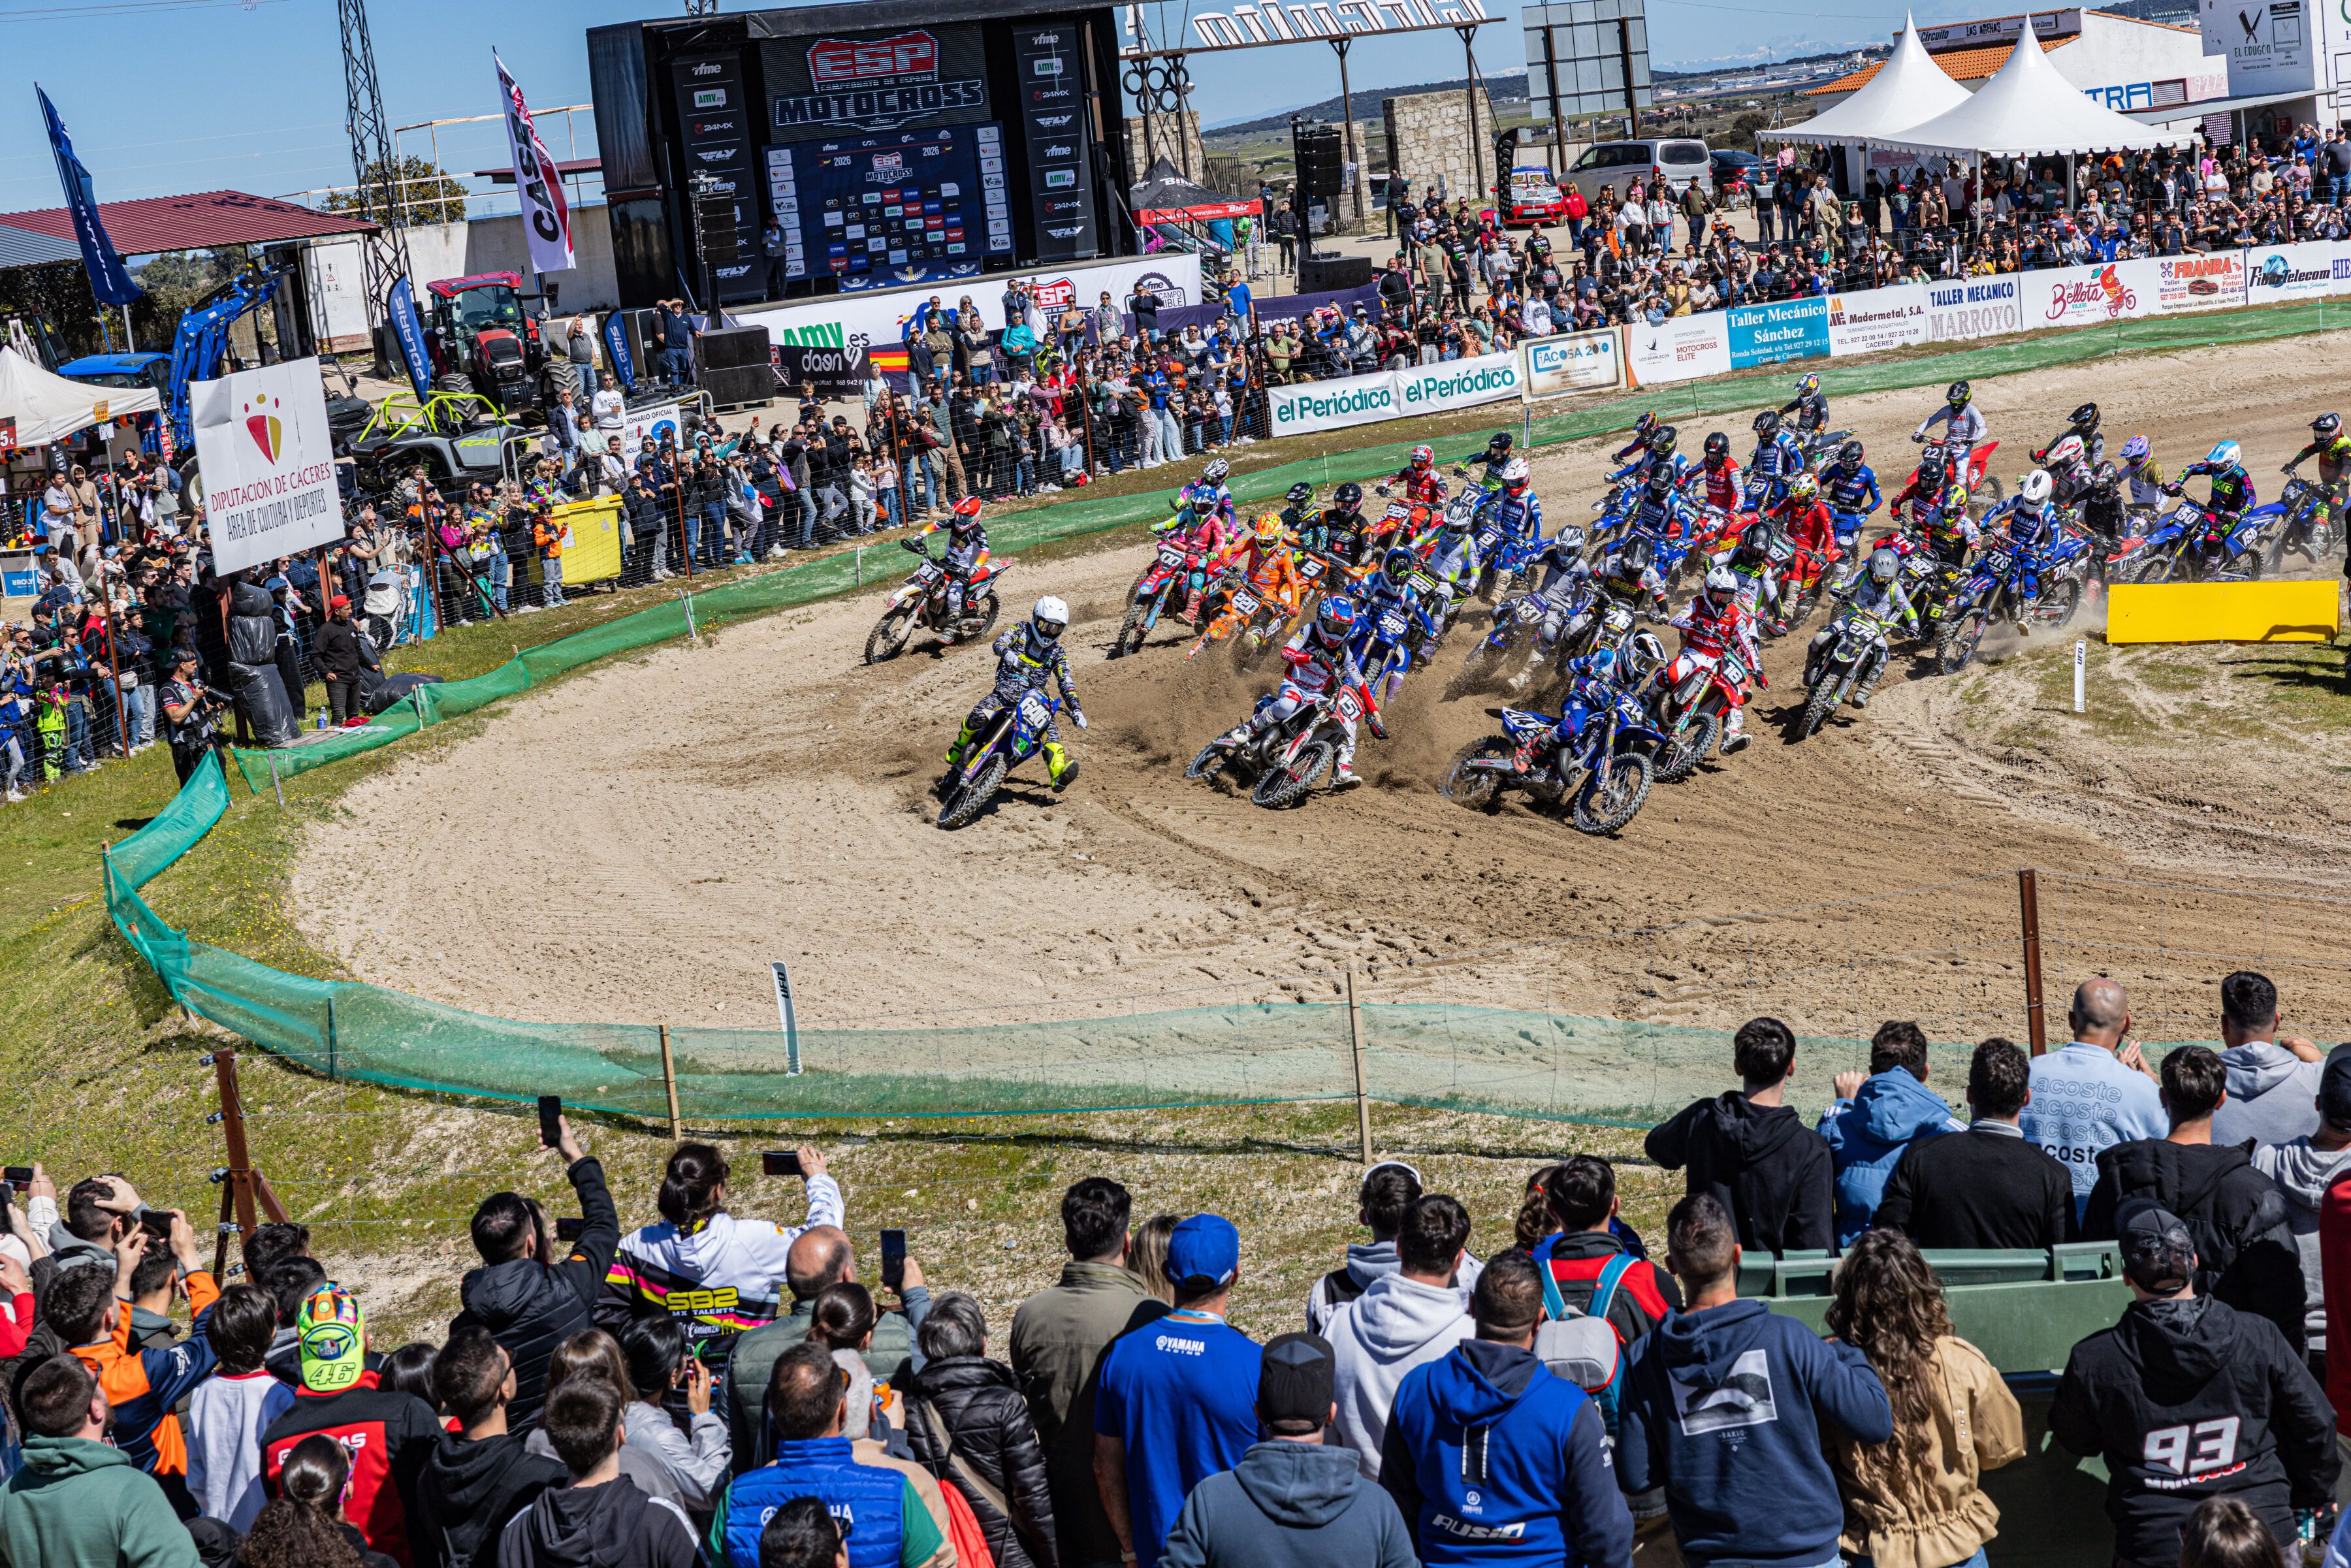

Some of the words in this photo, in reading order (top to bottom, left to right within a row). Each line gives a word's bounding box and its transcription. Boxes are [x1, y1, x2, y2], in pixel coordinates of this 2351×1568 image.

[1032, 33, 1059, 45] rfme
[1921, 29, 1949, 42] Circuito
[1966, 25, 1977, 37] LAS
[1979, 22, 2001, 35] ARENAS
[816, 42, 932, 78] ESP
[693, 63, 722, 76] rfme
[1043, 89, 1070, 98] 24MX
[2085, 82, 2152, 110] TRA
[776, 79, 984, 126] MOTOCROSS
[704, 122, 733, 131] 24MX
[1036, 115, 1073, 124] FLY
[697, 148, 737, 159] FLY
[923, 146, 939, 156] 2026
[1045, 144, 1072, 157] rfme
[834, 156, 851, 166] 2026
[874, 155, 901, 167] ESP
[866, 168, 913, 182] MOTOCROSS
[1160, 176, 1195, 187] Bihr
[1054, 200, 1081, 210] 24MX
[1047, 225, 1084, 235] FLY
[905, 266, 914, 280] 1
[959, 264, 968, 274] 3
[2174, 257, 2232, 279] FRANRA
[2284, 283, 2308, 292] Networking
[2309, 281, 2329, 291] Solutions
[1159, 290, 1181, 300] CAMPO
[1930, 287, 1964, 308] TALLER
[1967, 281, 2014, 303] MECANICO
[2045, 281, 2104, 320] Bellota
[1727, 311, 1765, 328] Taller
[1768, 303, 1826, 321] Mecánico
[1849, 308, 1907, 325] Madermetal,
[1909, 304, 1925, 316] S.A.
[1930, 304, 2017, 339] MARROYO
[1754, 325, 1804, 344] Sánchez
[1847, 325, 1877, 334] SUMINISTROS
[1877, 320, 1909, 330] INDUSTRIALES
[394, 295, 426, 381] POLARIS
[1865, 340, 1894, 349] CACERES
[1585, 342, 1609, 356] 2010
[1676, 342, 1718, 354] MOTOCROSS
[1731, 349, 1750, 359] Ronda
[1750, 346, 1774, 357] Soledad,
[1774, 344, 1783, 353] s/n
[1677, 352, 1696, 362] ELITE
[1757, 355, 1773, 364] Casar
[1782, 351, 1804, 360] Cáceres
[1485, 364, 1512, 372] Extremadura
[1362, 384, 1390, 393] Extremadura
[1406, 379, 1422, 403] el
[1423, 367, 1516, 400] Periódico
[1277, 398, 1295, 423] el
[1300, 388, 1391, 420] Periódico
[651, 408, 673, 419] OFICIAL
[458, 438, 498, 448] RZR
[1926, 447, 1940, 458] 22
[211, 477, 272, 512] DIPUTACIÓN
[274, 471, 289, 494] DE
[289, 462, 331, 489] CÁCERES
[1748, 481, 1766, 494] 223
[1836, 491, 1855, 501] YAMAHA
[226, 511, 249, 541] ÁREA
[248, 513, 259, 534] DE
[260, 503, 289, 534] CULTURA
[288, 500, 293, 528] Y
[293, 487, 327, 522] DEPORTES
[1386, 504, 1409, 517] 229
[1503, 503, 1523, 516] YAMAHA
[1642, 502, 1664, 516] YAMAHA
[2173, 507, 2200, 526] 150
[2014, 513, 2038, 528] YAMAHA
[1478, 532, 1496, 546] 9
[1893, 532, 1915, 551] 374
[2241, 526, 2259, 547] 150
[1160, 551, 1183, 567] 100
[1986, 550, 2012, 569] 276
[1303, 560, 1323, 577] 5
[1735, 564, 1761, 577] UFO
[2053, 562, 2071, 581] 276
[1208, 577, 1225, 596] 100
[1232, 592, 1260, 615] 220
[1265, 617, 1281, 638] 220
[1379, 617, 1405, 636] 385
[1849, 621, 1876, 642] 274
[1725, 665, 1744, 684] 16
[1019, 696, 1051, 730] 646
[1337, 695, 1363, 720] 151
[777, 971, 790, 1000] UFO
[2028, 1075, 2123, 1104] Lacoste
[2025, 1096, 2118, 1125] Lacoste
[2024, 1117, 2114, 1146] Lacoste
[665, 1287, 739, 1311] SB2
[692, 1306, 735, 1316] TALENTS
[1157, 1347, 1202, 1356] RACING
[1166, 1336, 1205, 1353] YAMAHA
[309, 1362, 357, 1385] 46
[1721, 1429, 1746, 1438] BAKIO
[2144, 1415, 2241, 1477] 93
